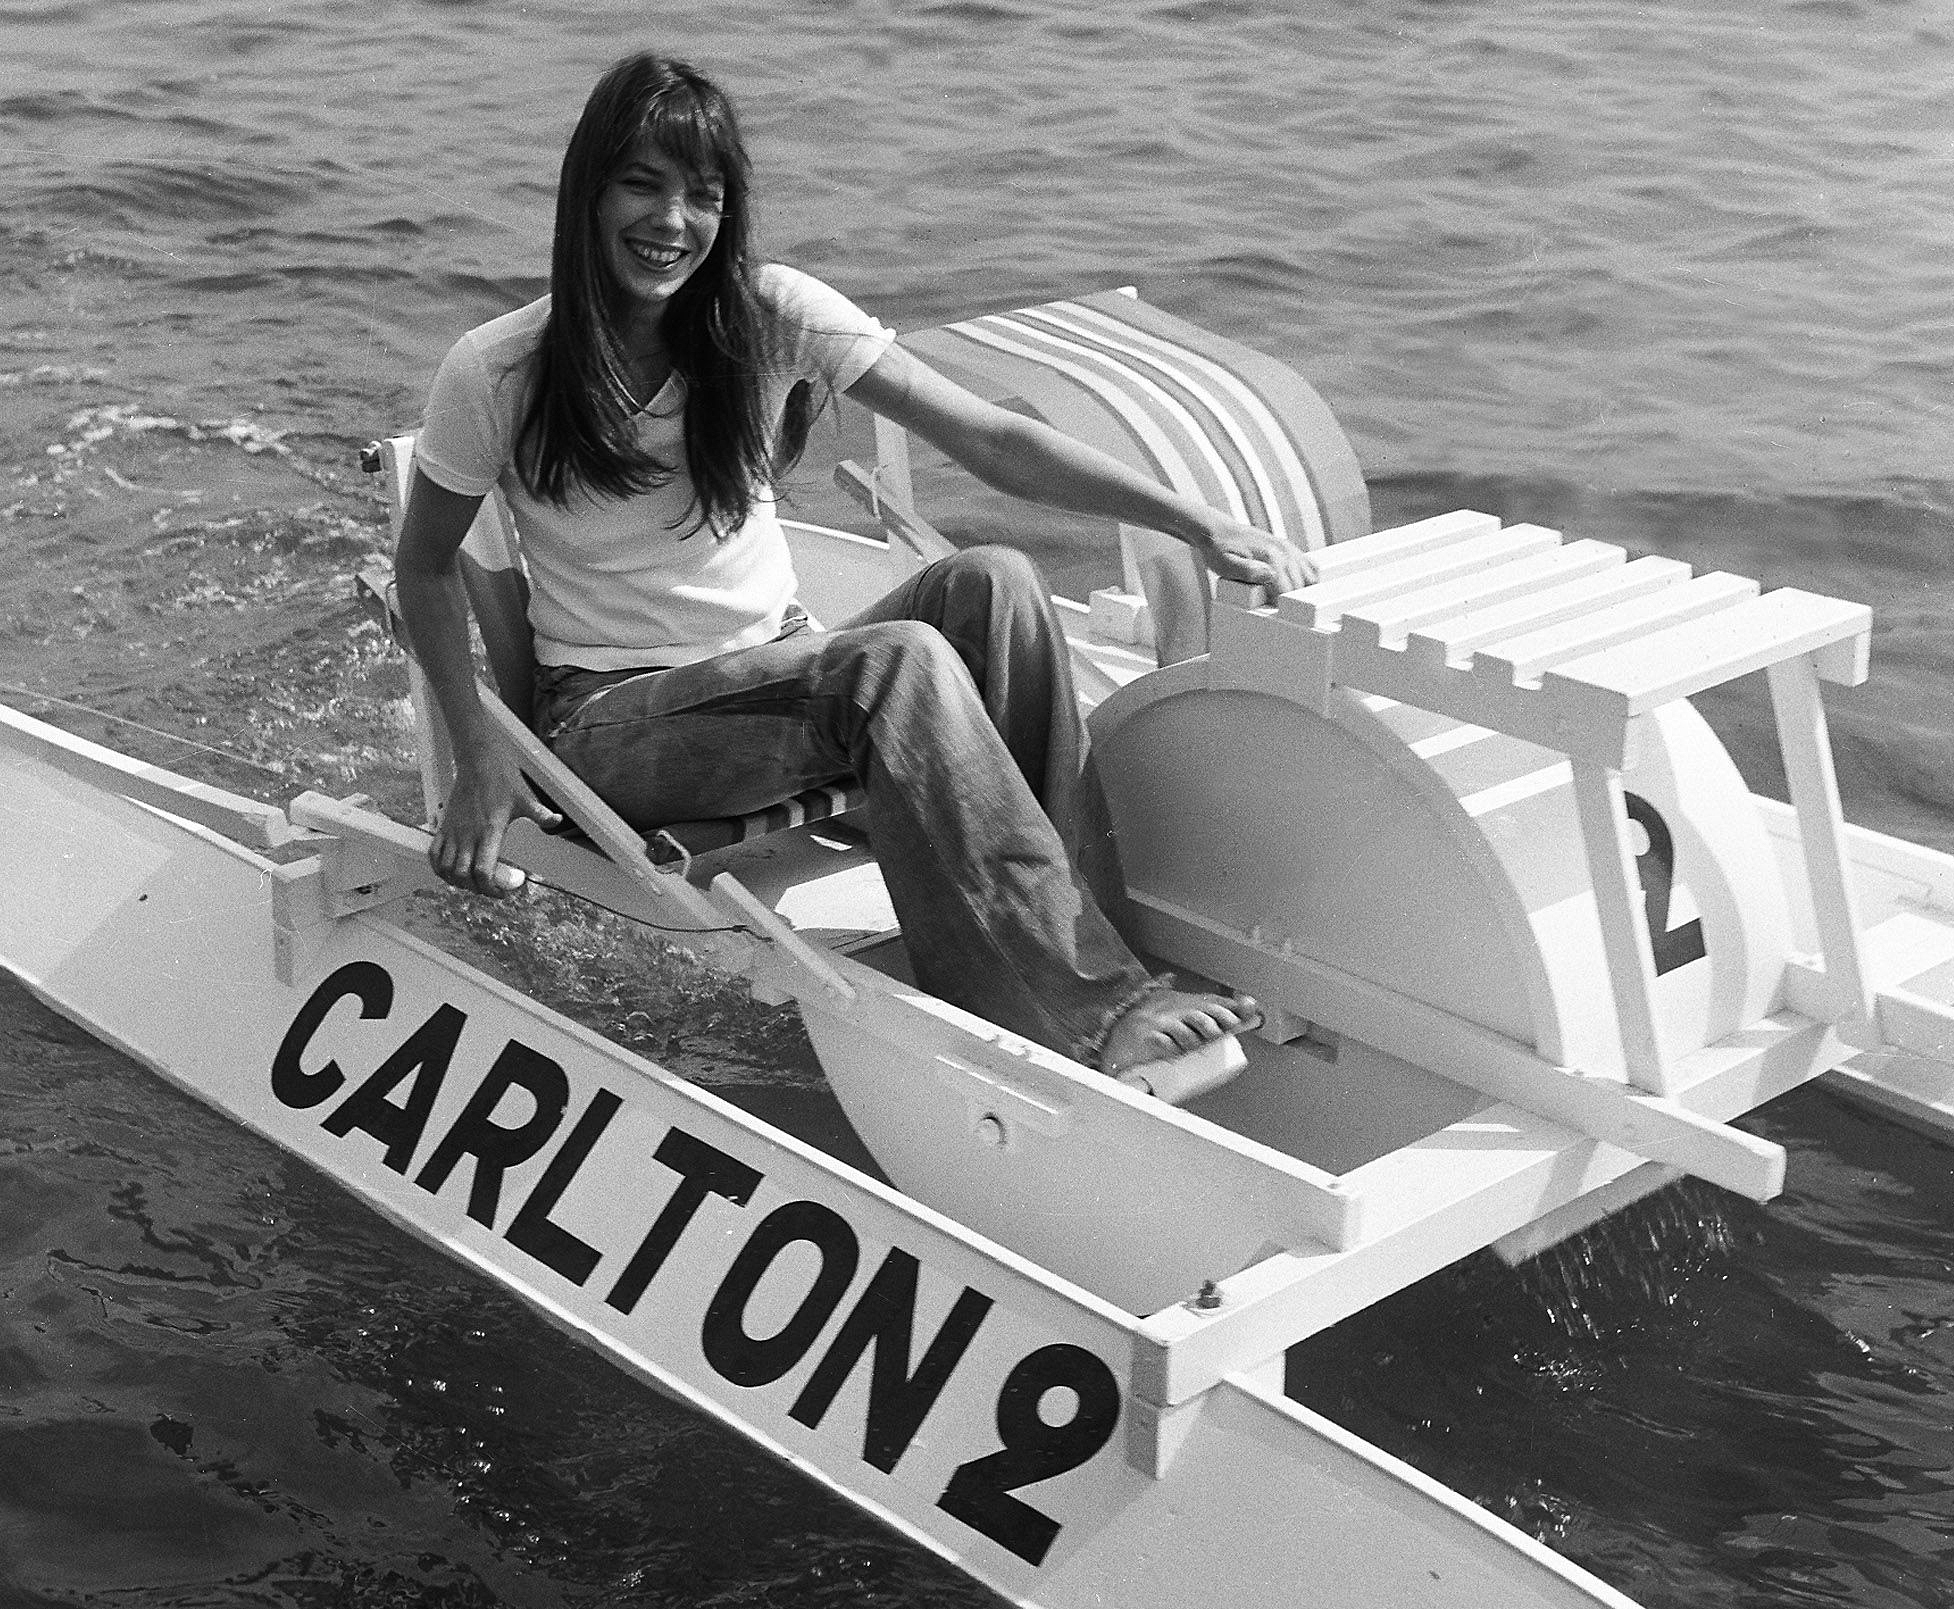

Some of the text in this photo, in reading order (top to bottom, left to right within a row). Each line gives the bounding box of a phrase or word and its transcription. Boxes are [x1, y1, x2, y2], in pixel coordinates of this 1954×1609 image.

[1623, 790, 1705, 976] 2
[271, 961, 1120, 1567] CARLTON 2
